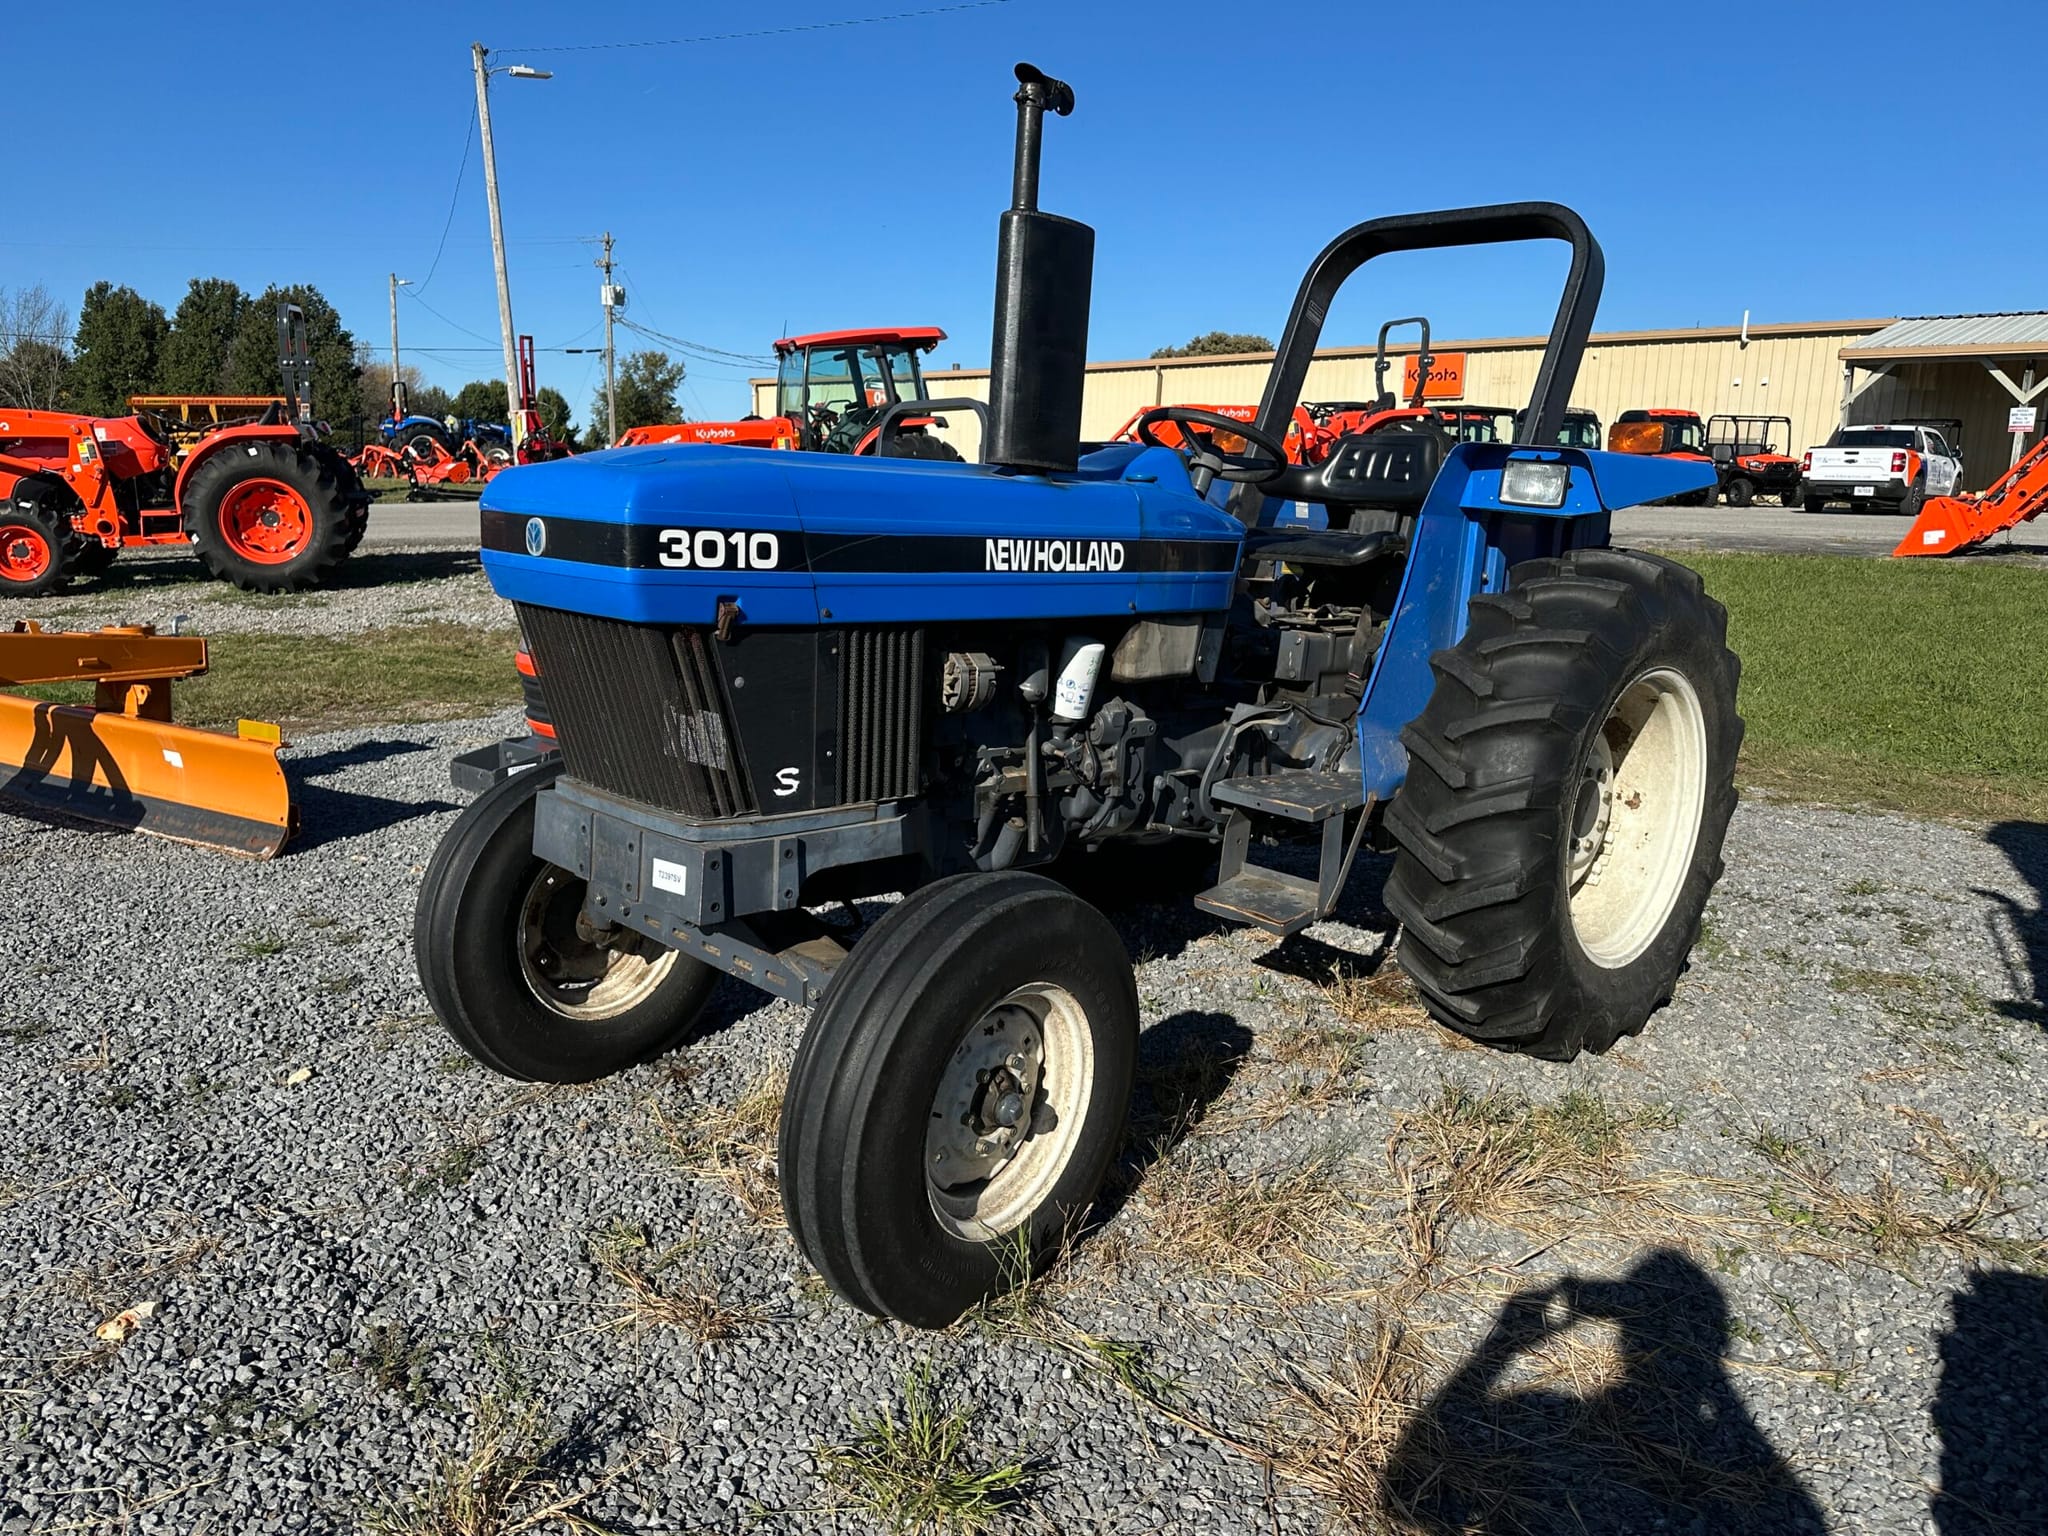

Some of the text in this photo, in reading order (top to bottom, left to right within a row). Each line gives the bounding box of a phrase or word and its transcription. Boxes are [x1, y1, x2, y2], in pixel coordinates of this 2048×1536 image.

[695, 427, 736, 439] Kubota
[659, 529, 779, 569] 3010
[985, 538, 1125, 572] NEW HOLLAND
[773, 767, 800, 796] S
